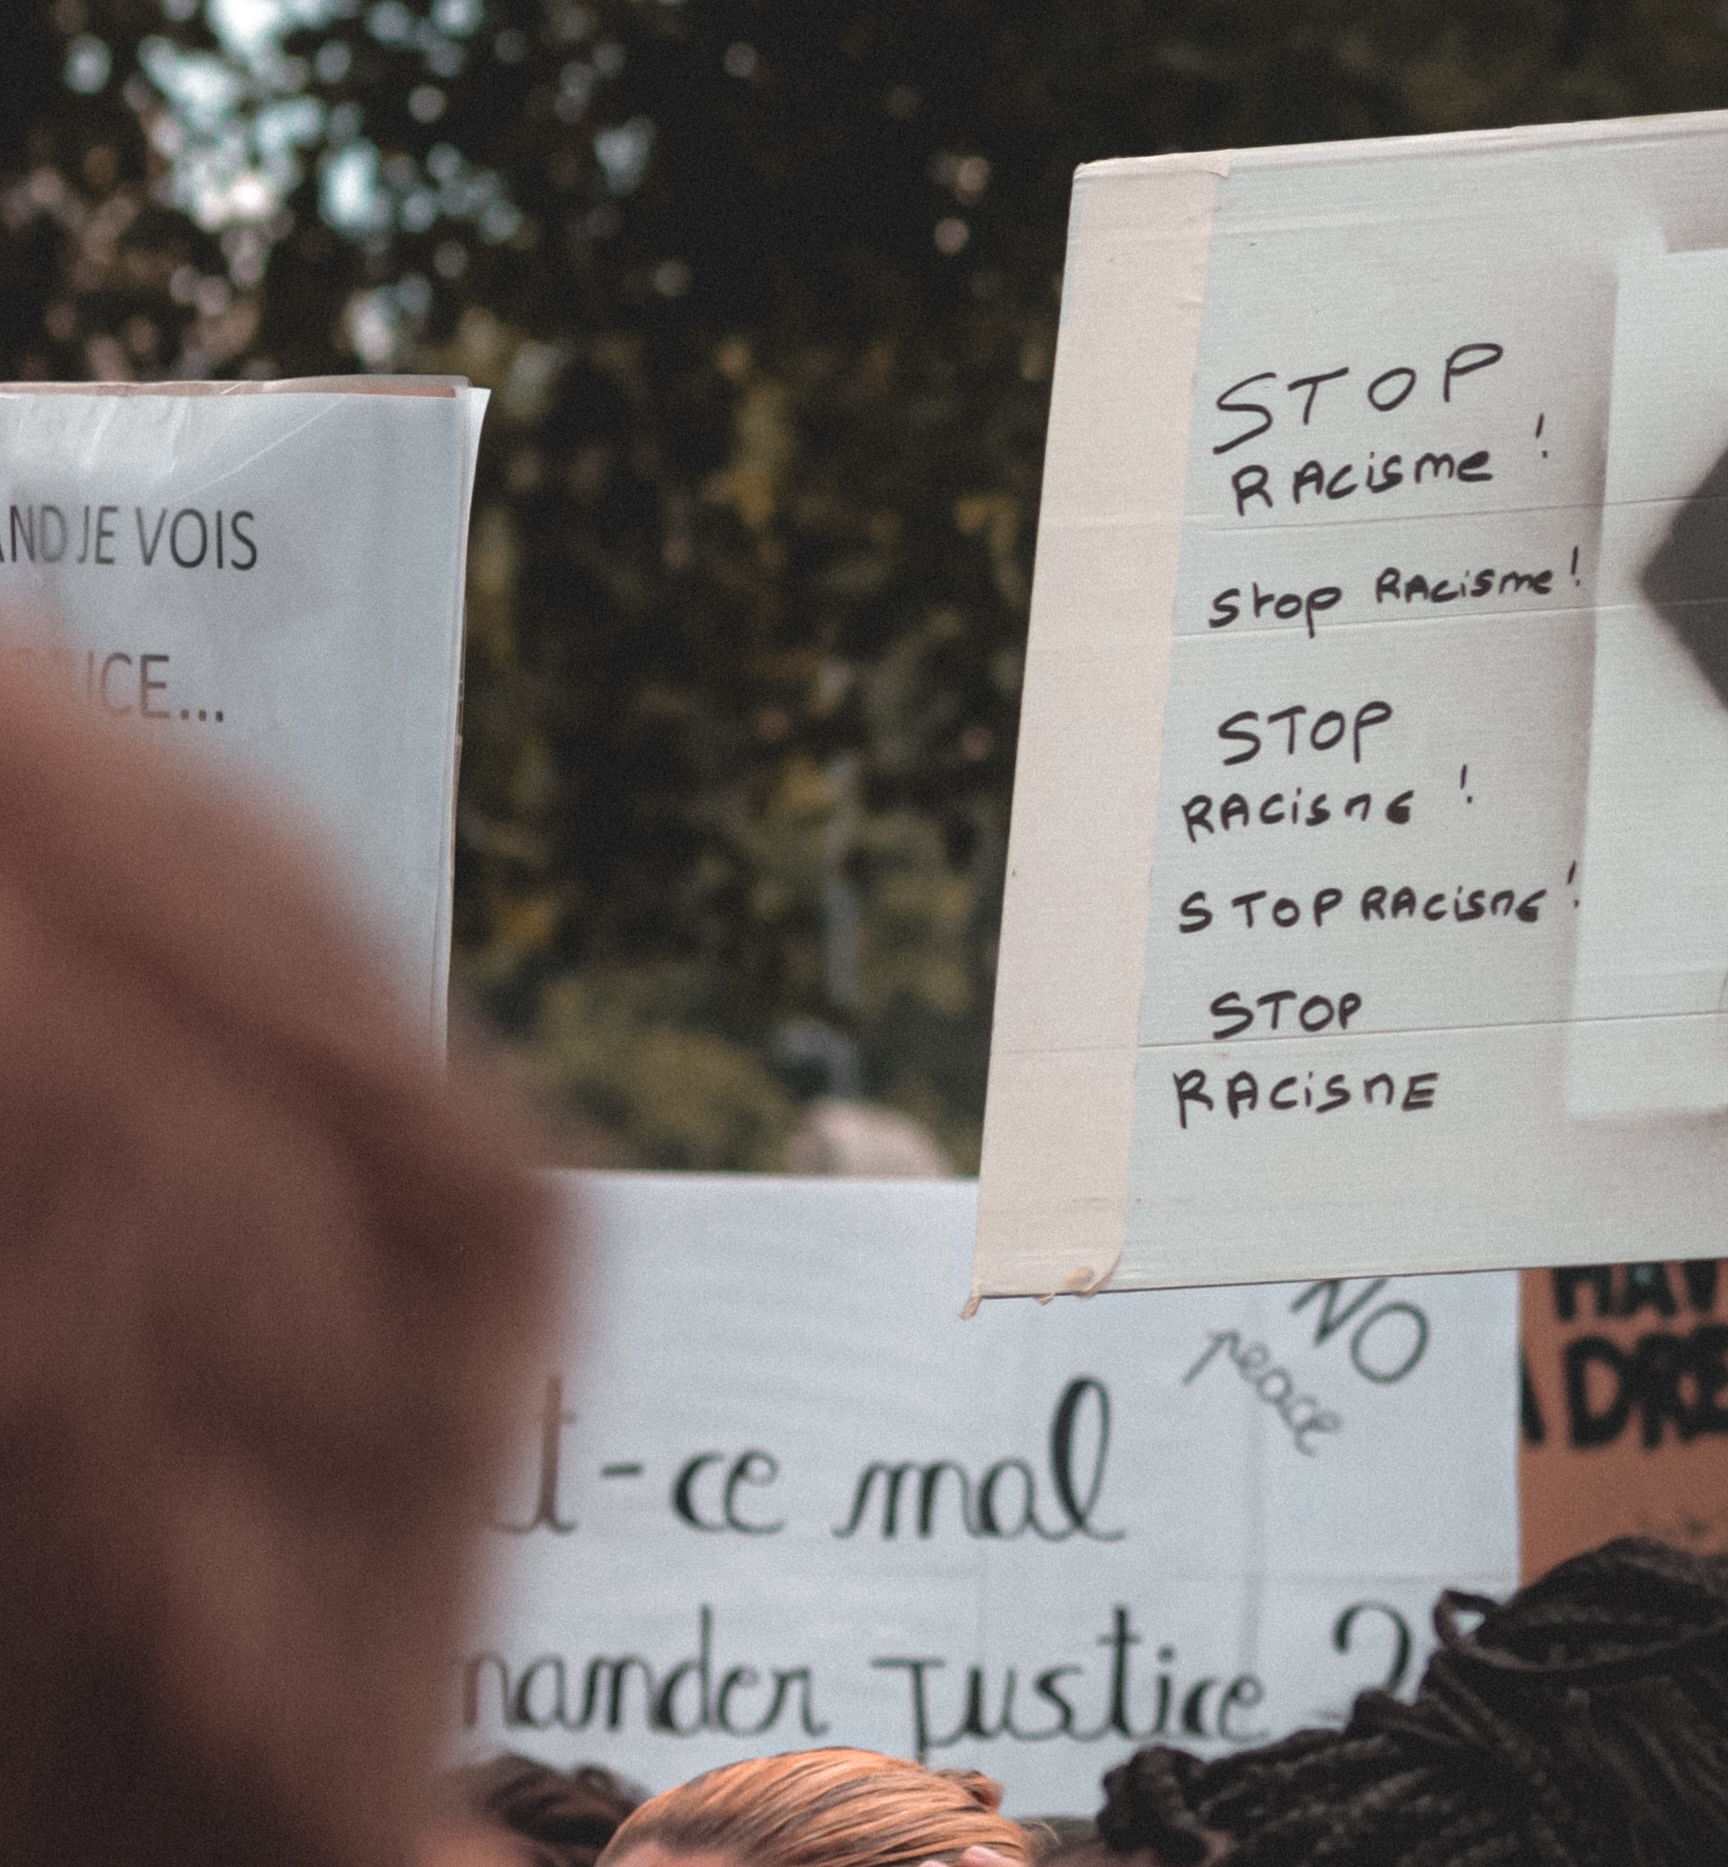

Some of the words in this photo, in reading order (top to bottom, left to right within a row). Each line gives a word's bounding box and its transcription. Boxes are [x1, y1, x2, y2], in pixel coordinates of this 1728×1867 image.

[1211, 341, 1505, 457] STOP
[0, 503, 69, 564] ND
[77, 504, 119, 565] JE
[135, 506, 258, 571] VOIS
[1216, 699, 1395, 767] STOP
[1177, 886, 1345, 935] STOP
[1207, 988, 1364, 1042] STOP
[1289, 1276, 1430, 1386] NO
[1180, 1324, 1344, 1460] peace
[829, 1374, 1128, 1543] mal
